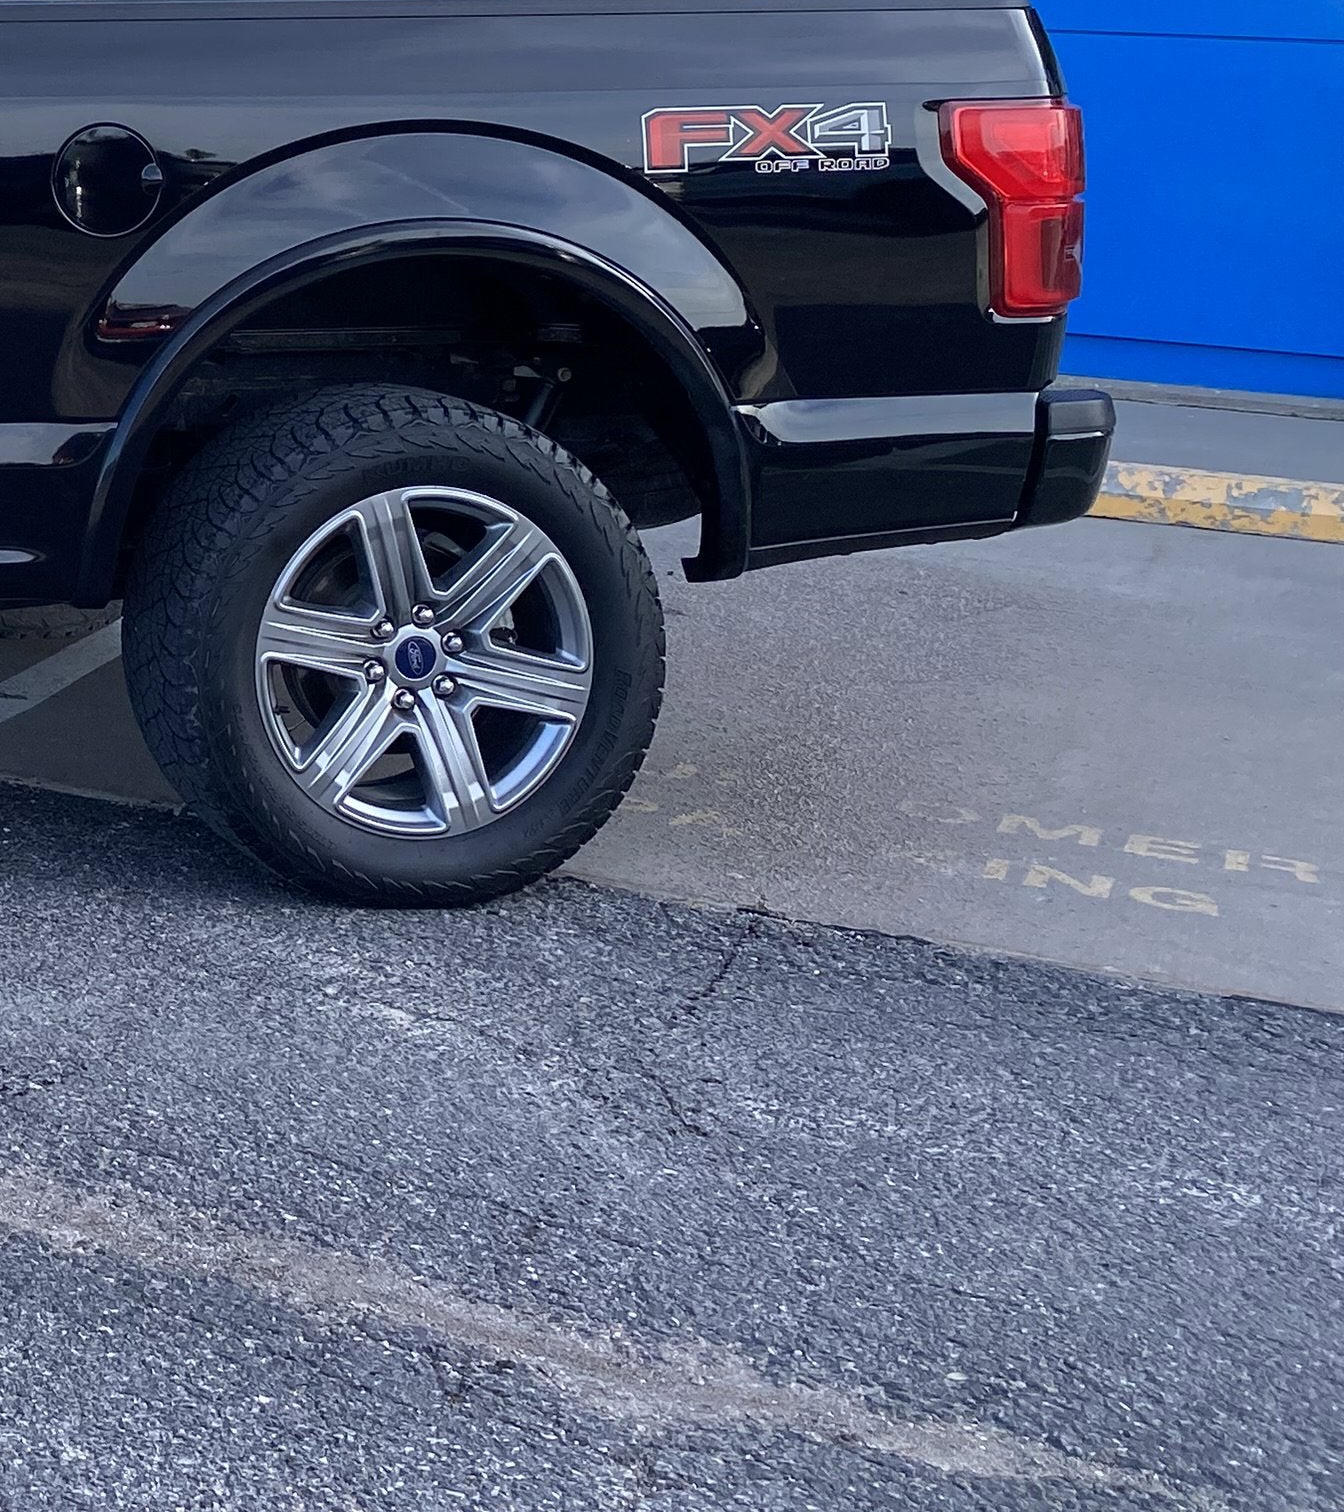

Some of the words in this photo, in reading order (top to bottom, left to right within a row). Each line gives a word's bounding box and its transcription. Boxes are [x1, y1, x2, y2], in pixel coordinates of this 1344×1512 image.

[641, 101, 893, 174] FX4
[754, 159, 810, 173] OFF
[818, 157, 891, 172] ROAD
